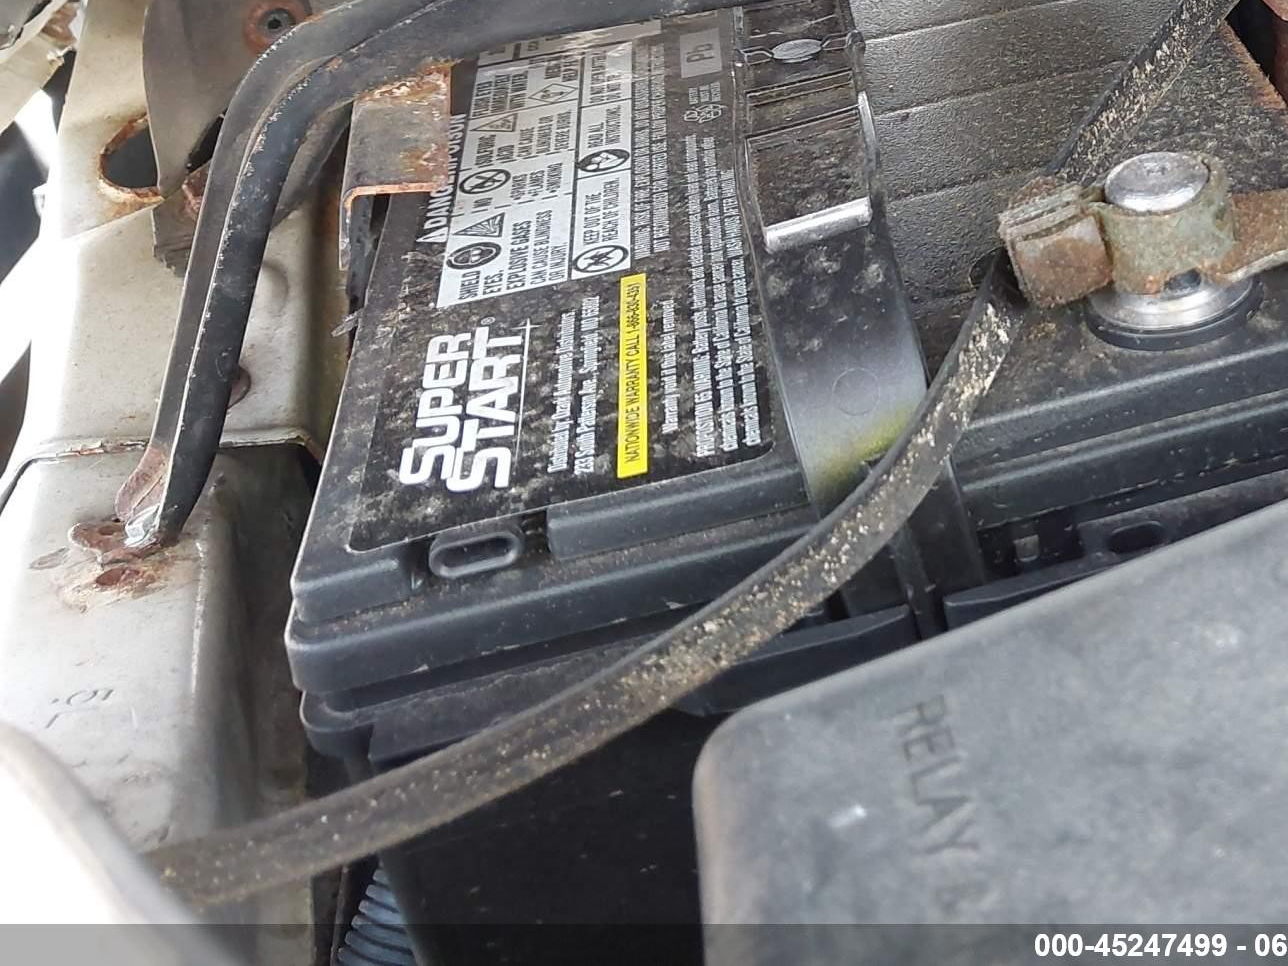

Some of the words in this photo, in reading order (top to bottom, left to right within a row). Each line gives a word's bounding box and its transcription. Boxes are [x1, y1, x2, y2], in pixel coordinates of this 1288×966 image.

[684, 42, 715, 63] Pb
[518, 127, 534, 145] CAUSE
[588, 122, 603, 133] ALL
[474, 134, 496, 165] SULFURIC
[554, 129, 570, 150] SEVERE
[587, 132, 602, 148] READ
[495, 144, 514, 161] ACID
[516, 144, 532, 157] CAN
[602, 177, 619, 210] CHILDREN.
[652, 178, 668, 192] FOR
[473, 196, 492, 208] NO
[585, 192, 601, 205] THE
[634, 201, 650, 211] OF
[720, 196, 738, 217] AFTER
[584, 204, 600, 215] OF
[602, 209, 618, 219] OF
[634, 209, 650, 226] RISK
[652, 191, 669, 238] RECOMMENDED
[511, 219, 532, 245] GASES
[534, 209, 553, 246] BLINDNESS
[583, 215, 600, 228] OUT
[601, 218, 618, 241] REACH
[722, 215, 741, 238] HANDS
[582, 228, 599, 245] KEEP
[633, 225, 650, 259] WARNING:
[653, 237, 670, 252] NOT
[531, 245, 549, 269] CAUSE
[549, 241, 567, 269] INJURY.
[724, 237, 743, 258] WASH
[505, 245, 529, 290] EXPLOSIVE
[529, 269, 547, 285] CAN
[548, 268, 565, 280] OR
[706, 262, 725, 284] cancer
[457, 270, 481, 300] SHIELD
[481, 269, 503, 295] EYES.
[708, 282, 727, 302] cause
[728, 278, 747, 298] cause
[687, 279, 706, 309] terminals
[581, 316, 599, 331] MO
[710, 308, 731, 341] California
[730, 303, 751, 337] California
[625, 333, 640, 356] CALL
[659, 331, 676, 352] label
[690, 327, 712, 353] Battery
[659, 351, 676, 368] this
[713, 348, 733, 368] State
[734, 343, 754, 363] State
[552, 351, 574, 396] Automotive
[660, 367, 677, 375] if
[714, 366, 734, 380] the
[735, 361, 756, 375] the
[736, 373, 757, 383] to
[625, 356, 640, 405] WARRANTY
[660, 374, 677, 394] void
[715, 378, 735, 388] to
[693, 390, 713, 402] 65
[715, 386, 737, 412] known
[737, 381, 759, 407] known
[398, 334, 471, 487] SUPER
[445, 324, 525, 494] START
[551, 395, 571, 419] Ozark
[575, 393, 596, 433] Patterson
[660, 392, 681, 433] Warranty
[624, 405, 640, 462] NATIONWIDE
[694, 401, 716, 457] PROPOSITION
[717, 410, 741, 452] chemicals
[739, 404, 763, 446] chemicals
[547, 429, 569, 472] Distributed
[574, 431, 594, 458] South
[573, 456, 594, 475] 233
[896, 694, 981, 855] RELAY
